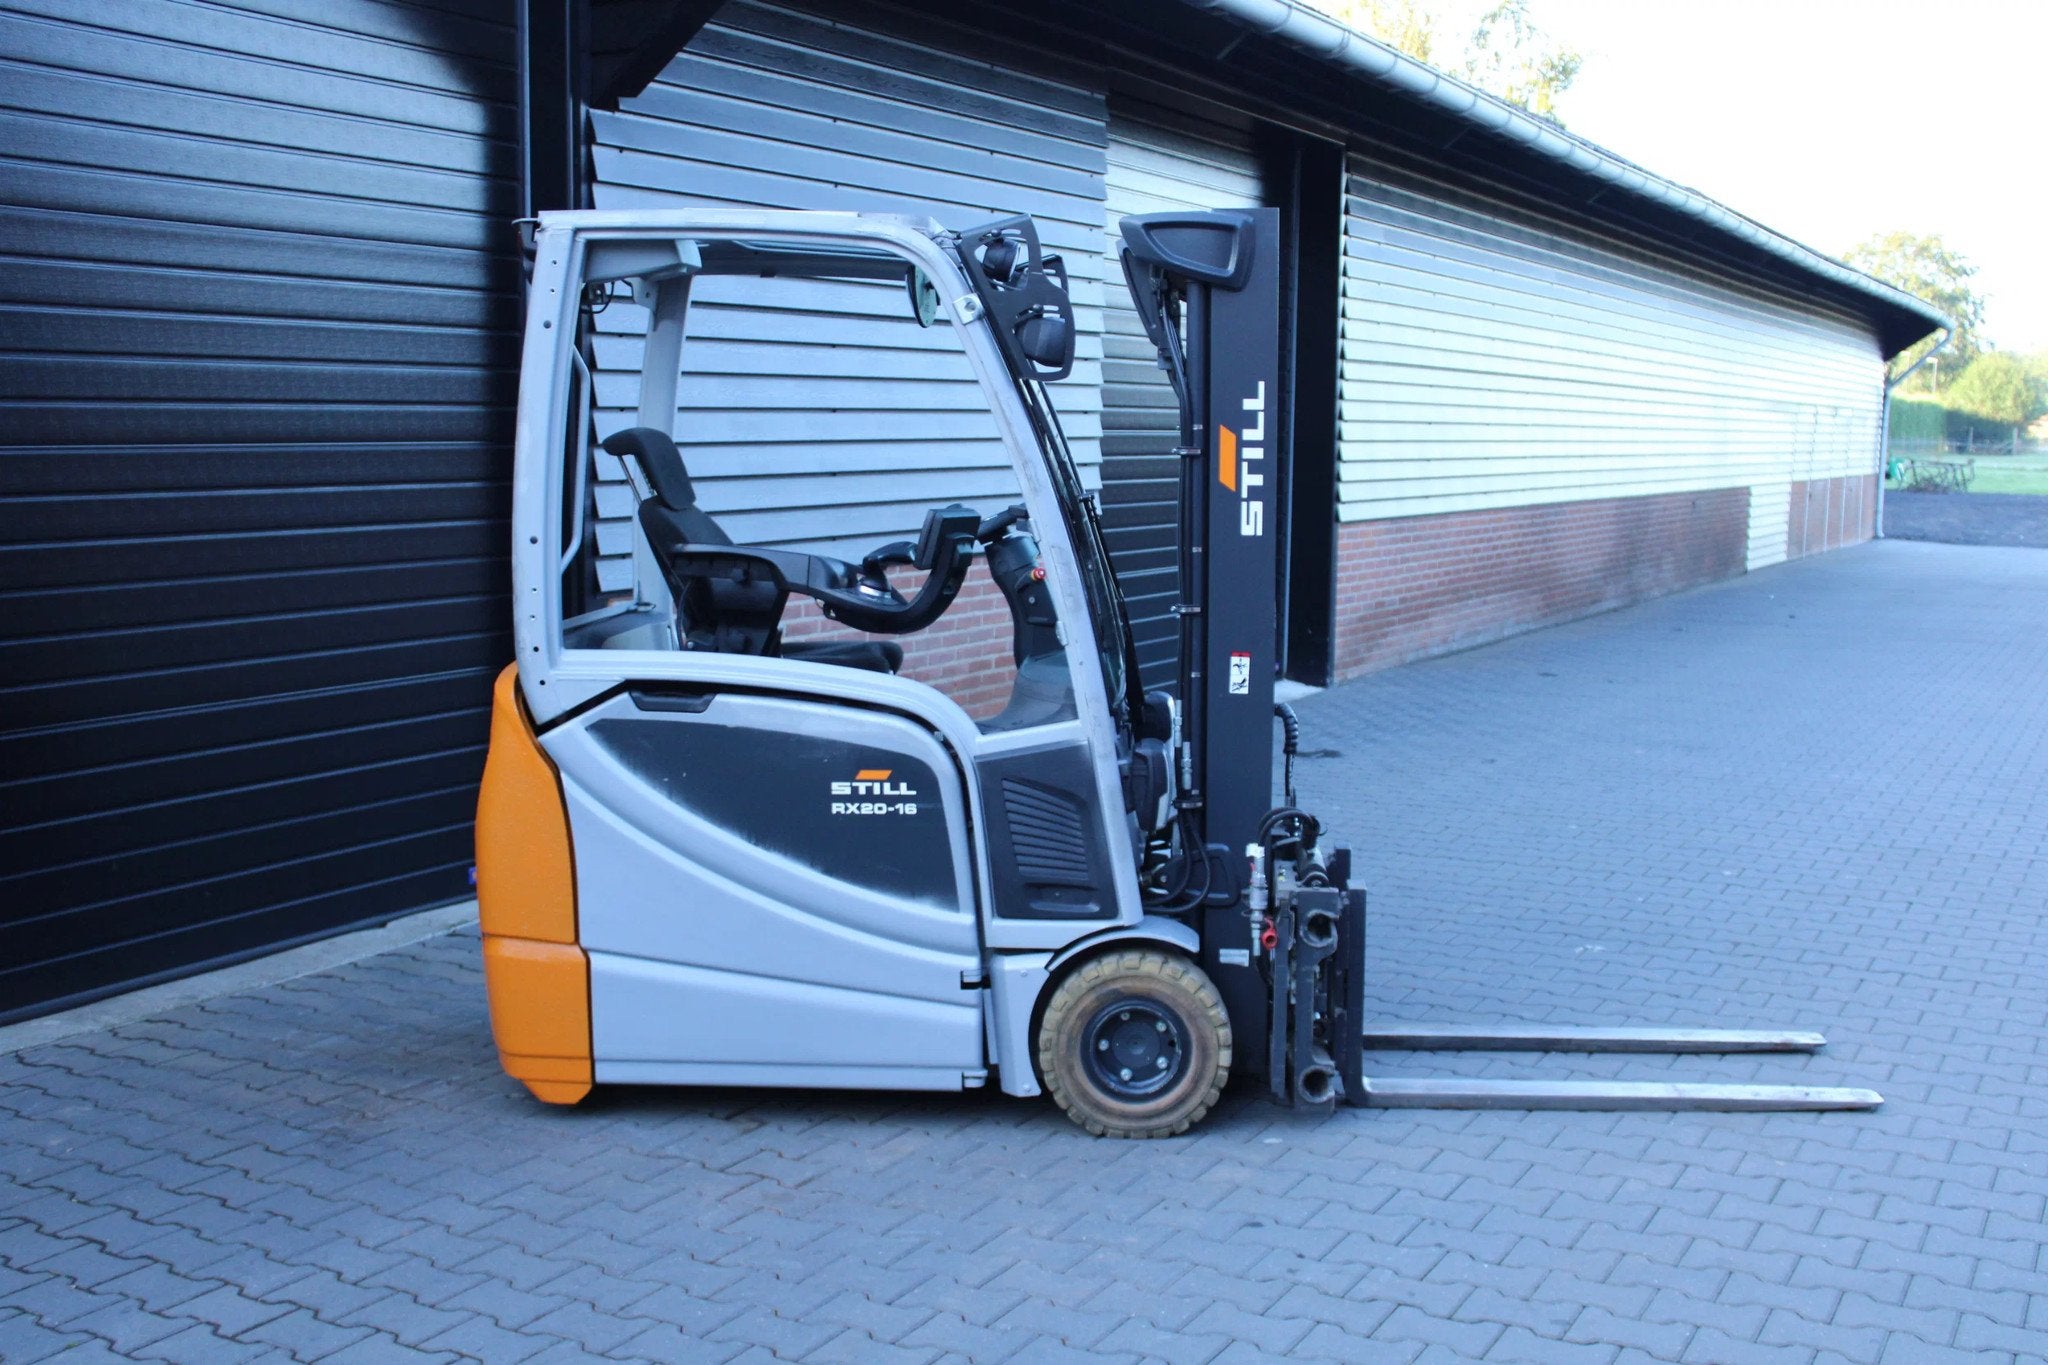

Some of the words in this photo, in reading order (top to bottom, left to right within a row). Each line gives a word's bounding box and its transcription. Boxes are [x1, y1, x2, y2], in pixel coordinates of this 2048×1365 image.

[1240, 381, 1265, 536] STILL
[831, 782, 917, 795] STILL
[831, 803, 917, 814] RX20-16
